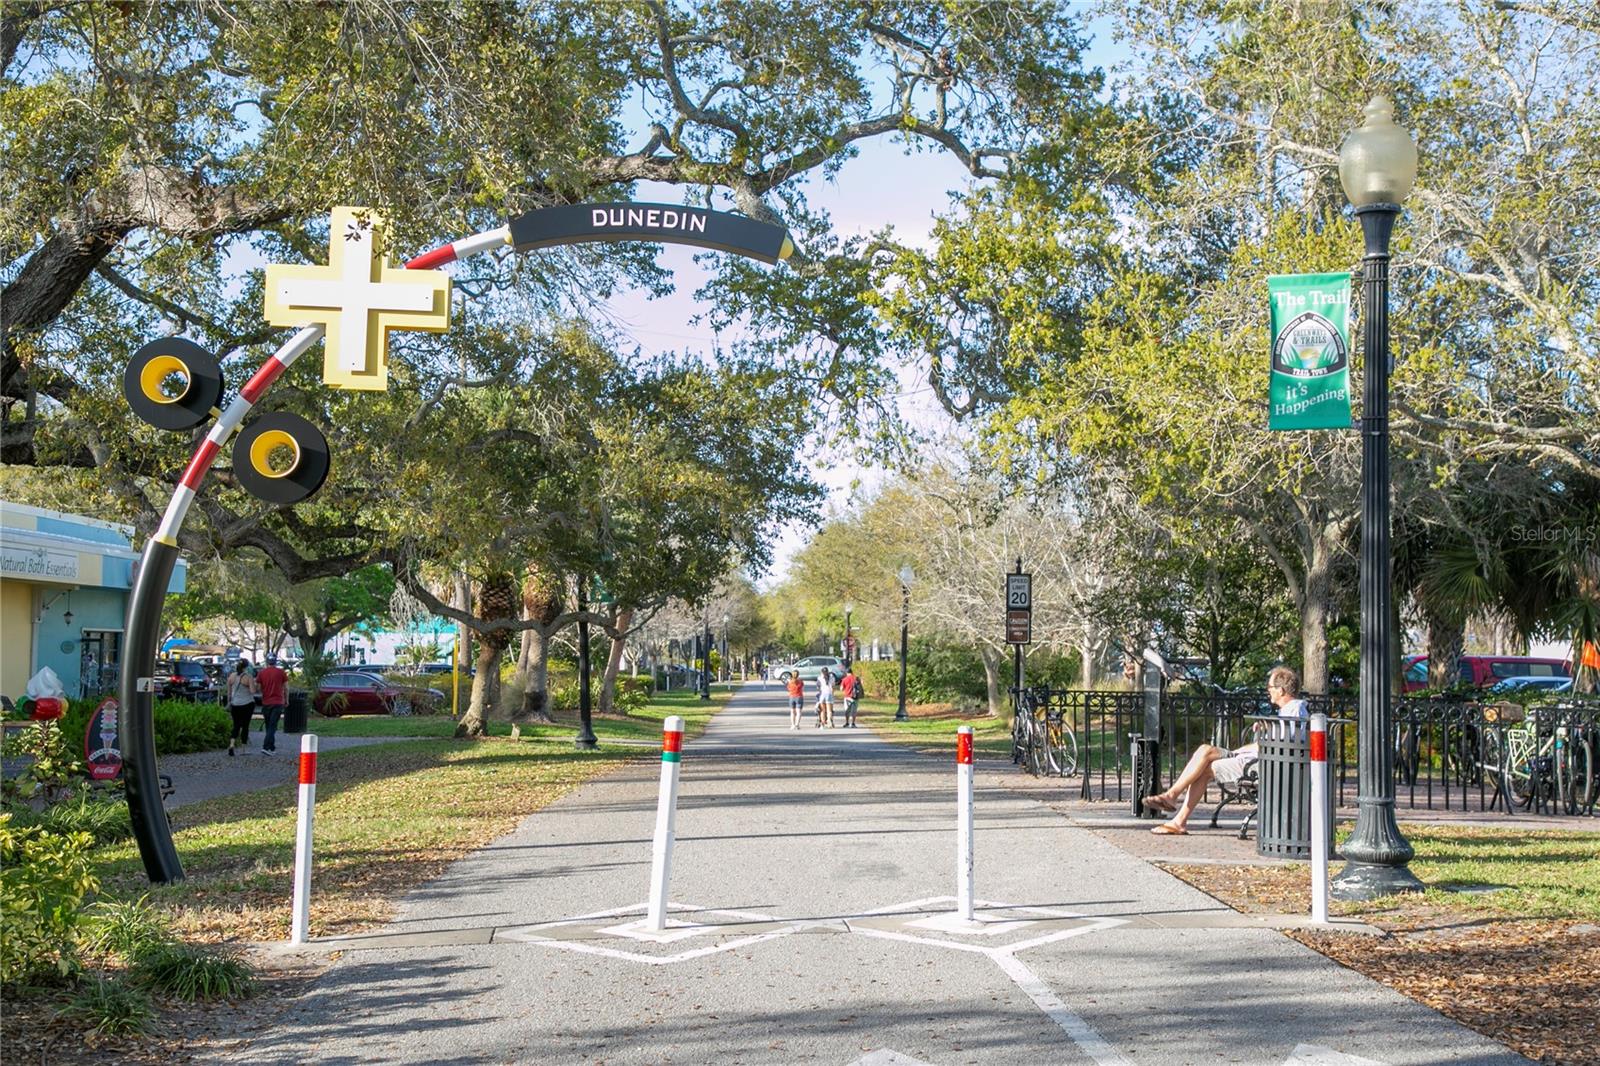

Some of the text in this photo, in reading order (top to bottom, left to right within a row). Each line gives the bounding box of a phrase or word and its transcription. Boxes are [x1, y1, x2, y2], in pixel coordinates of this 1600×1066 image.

[592, 208, 708, 233] DUNEDIN
[1273, 288, 1347, 306] The Trail
[1301, 335, 1327, 345] TRAILS
[1286, 382, 1308, 400] it's
[1275, 388, 1346, 416] Happening
[0, 555, 78, 578] Natural Bath Essentials
[1011, 591, 1027, 605] 20
